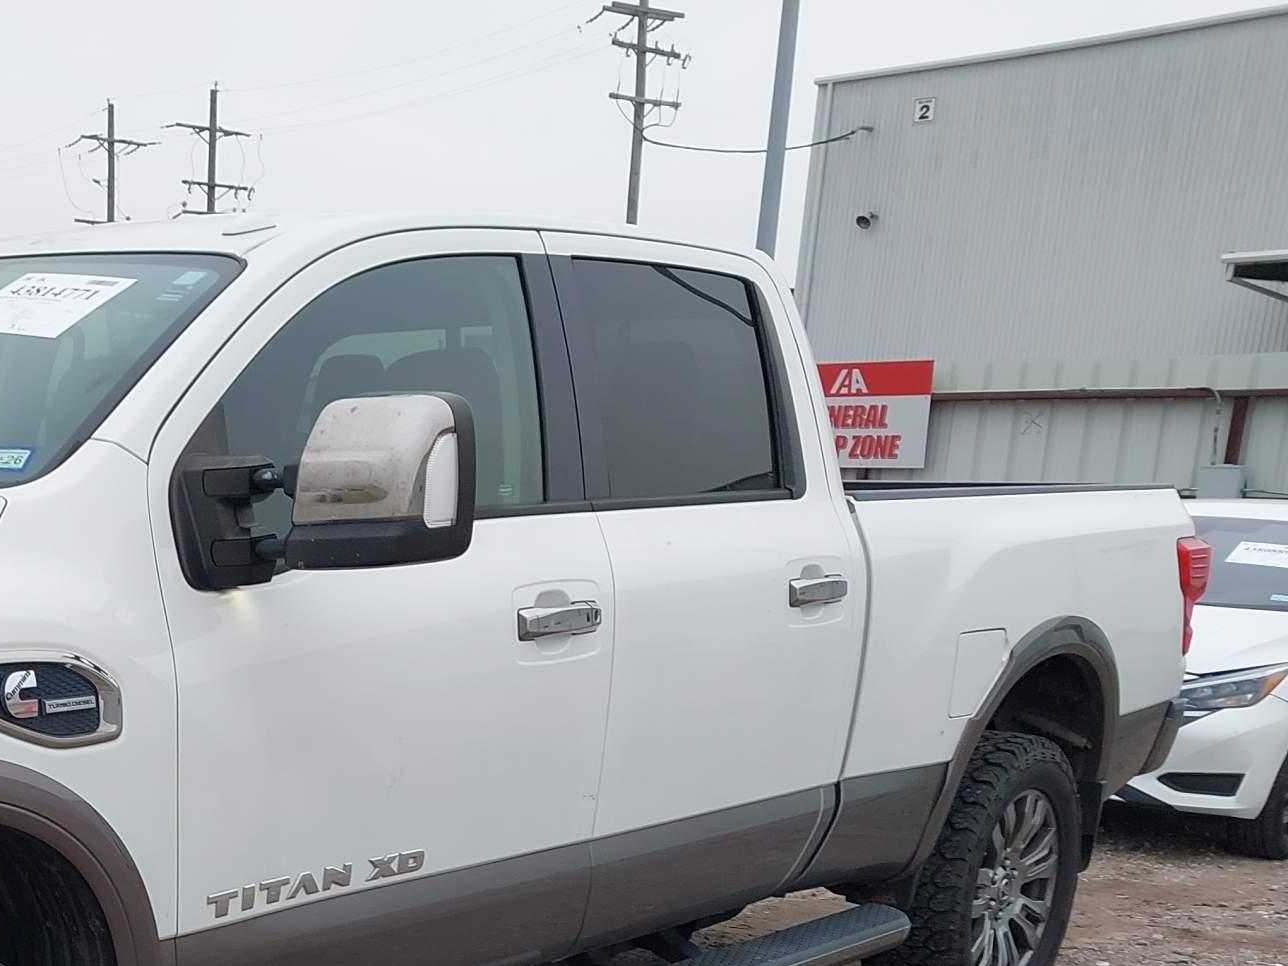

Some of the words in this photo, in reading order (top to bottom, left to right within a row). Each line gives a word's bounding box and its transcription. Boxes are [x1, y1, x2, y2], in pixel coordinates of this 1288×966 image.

[919, 104, 930, 120] 2
[827, 404, 889, 429] NERAL
[848, 434, 901, 459] ZONE
[207, 862, 353, 918] TITAN
[365, 849, 424, 882] XD
